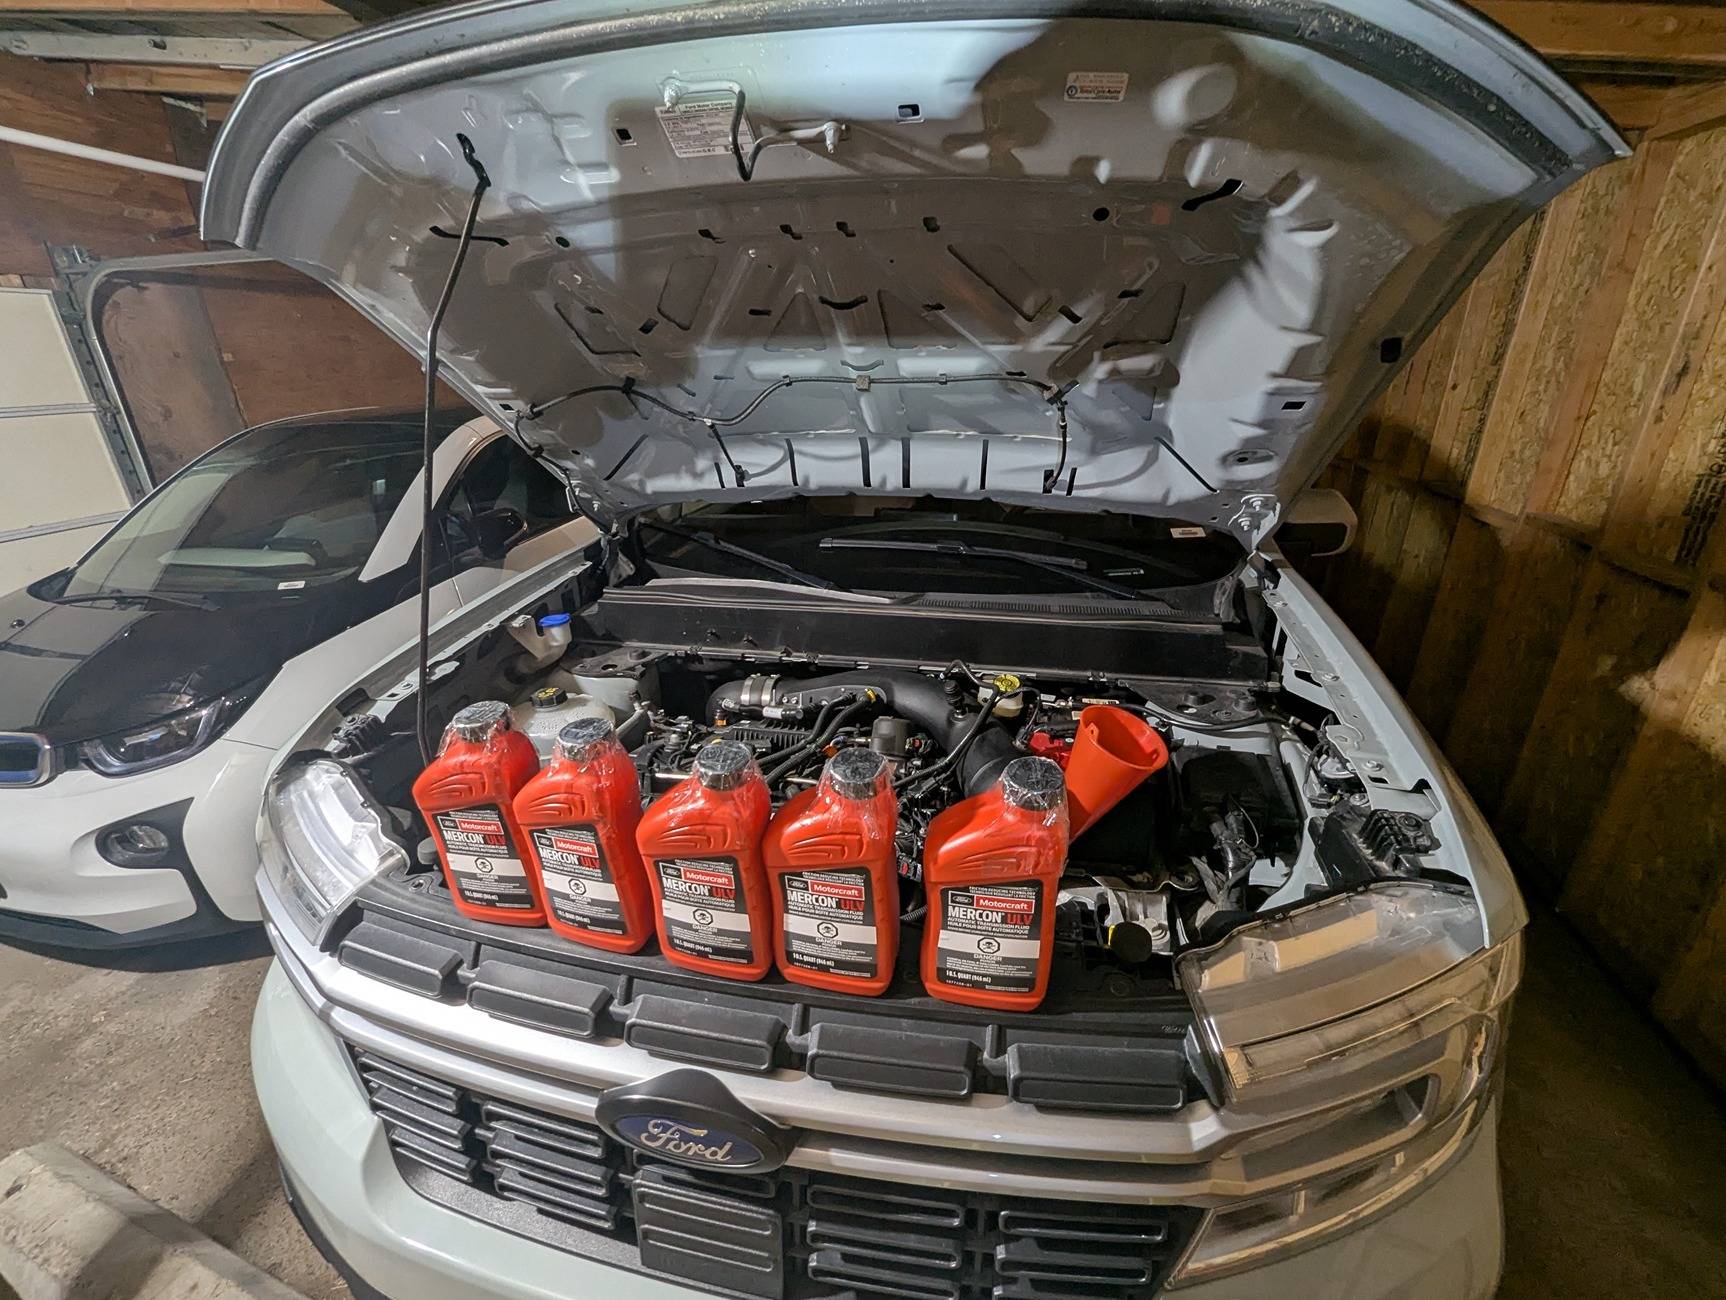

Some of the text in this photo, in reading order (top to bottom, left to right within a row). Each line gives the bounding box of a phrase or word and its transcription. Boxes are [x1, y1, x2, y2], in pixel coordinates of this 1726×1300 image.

[462, 823, 498, 831] Motorcraft
[558, 842, 592, 853] Motorcraft
[687, 873, 729, 884] Motorcraft
[662, 877, 736, 899] MERCON ULV
[814, 885, 859, 896] Motorcraft
[786, 890, 866, 911] MERCON ULV
[980, 900, 1028, 909] Motorcraft
[948, 906, 1033, 925] MERCON ULV
[640, 1119, 732, 1161] Ford
